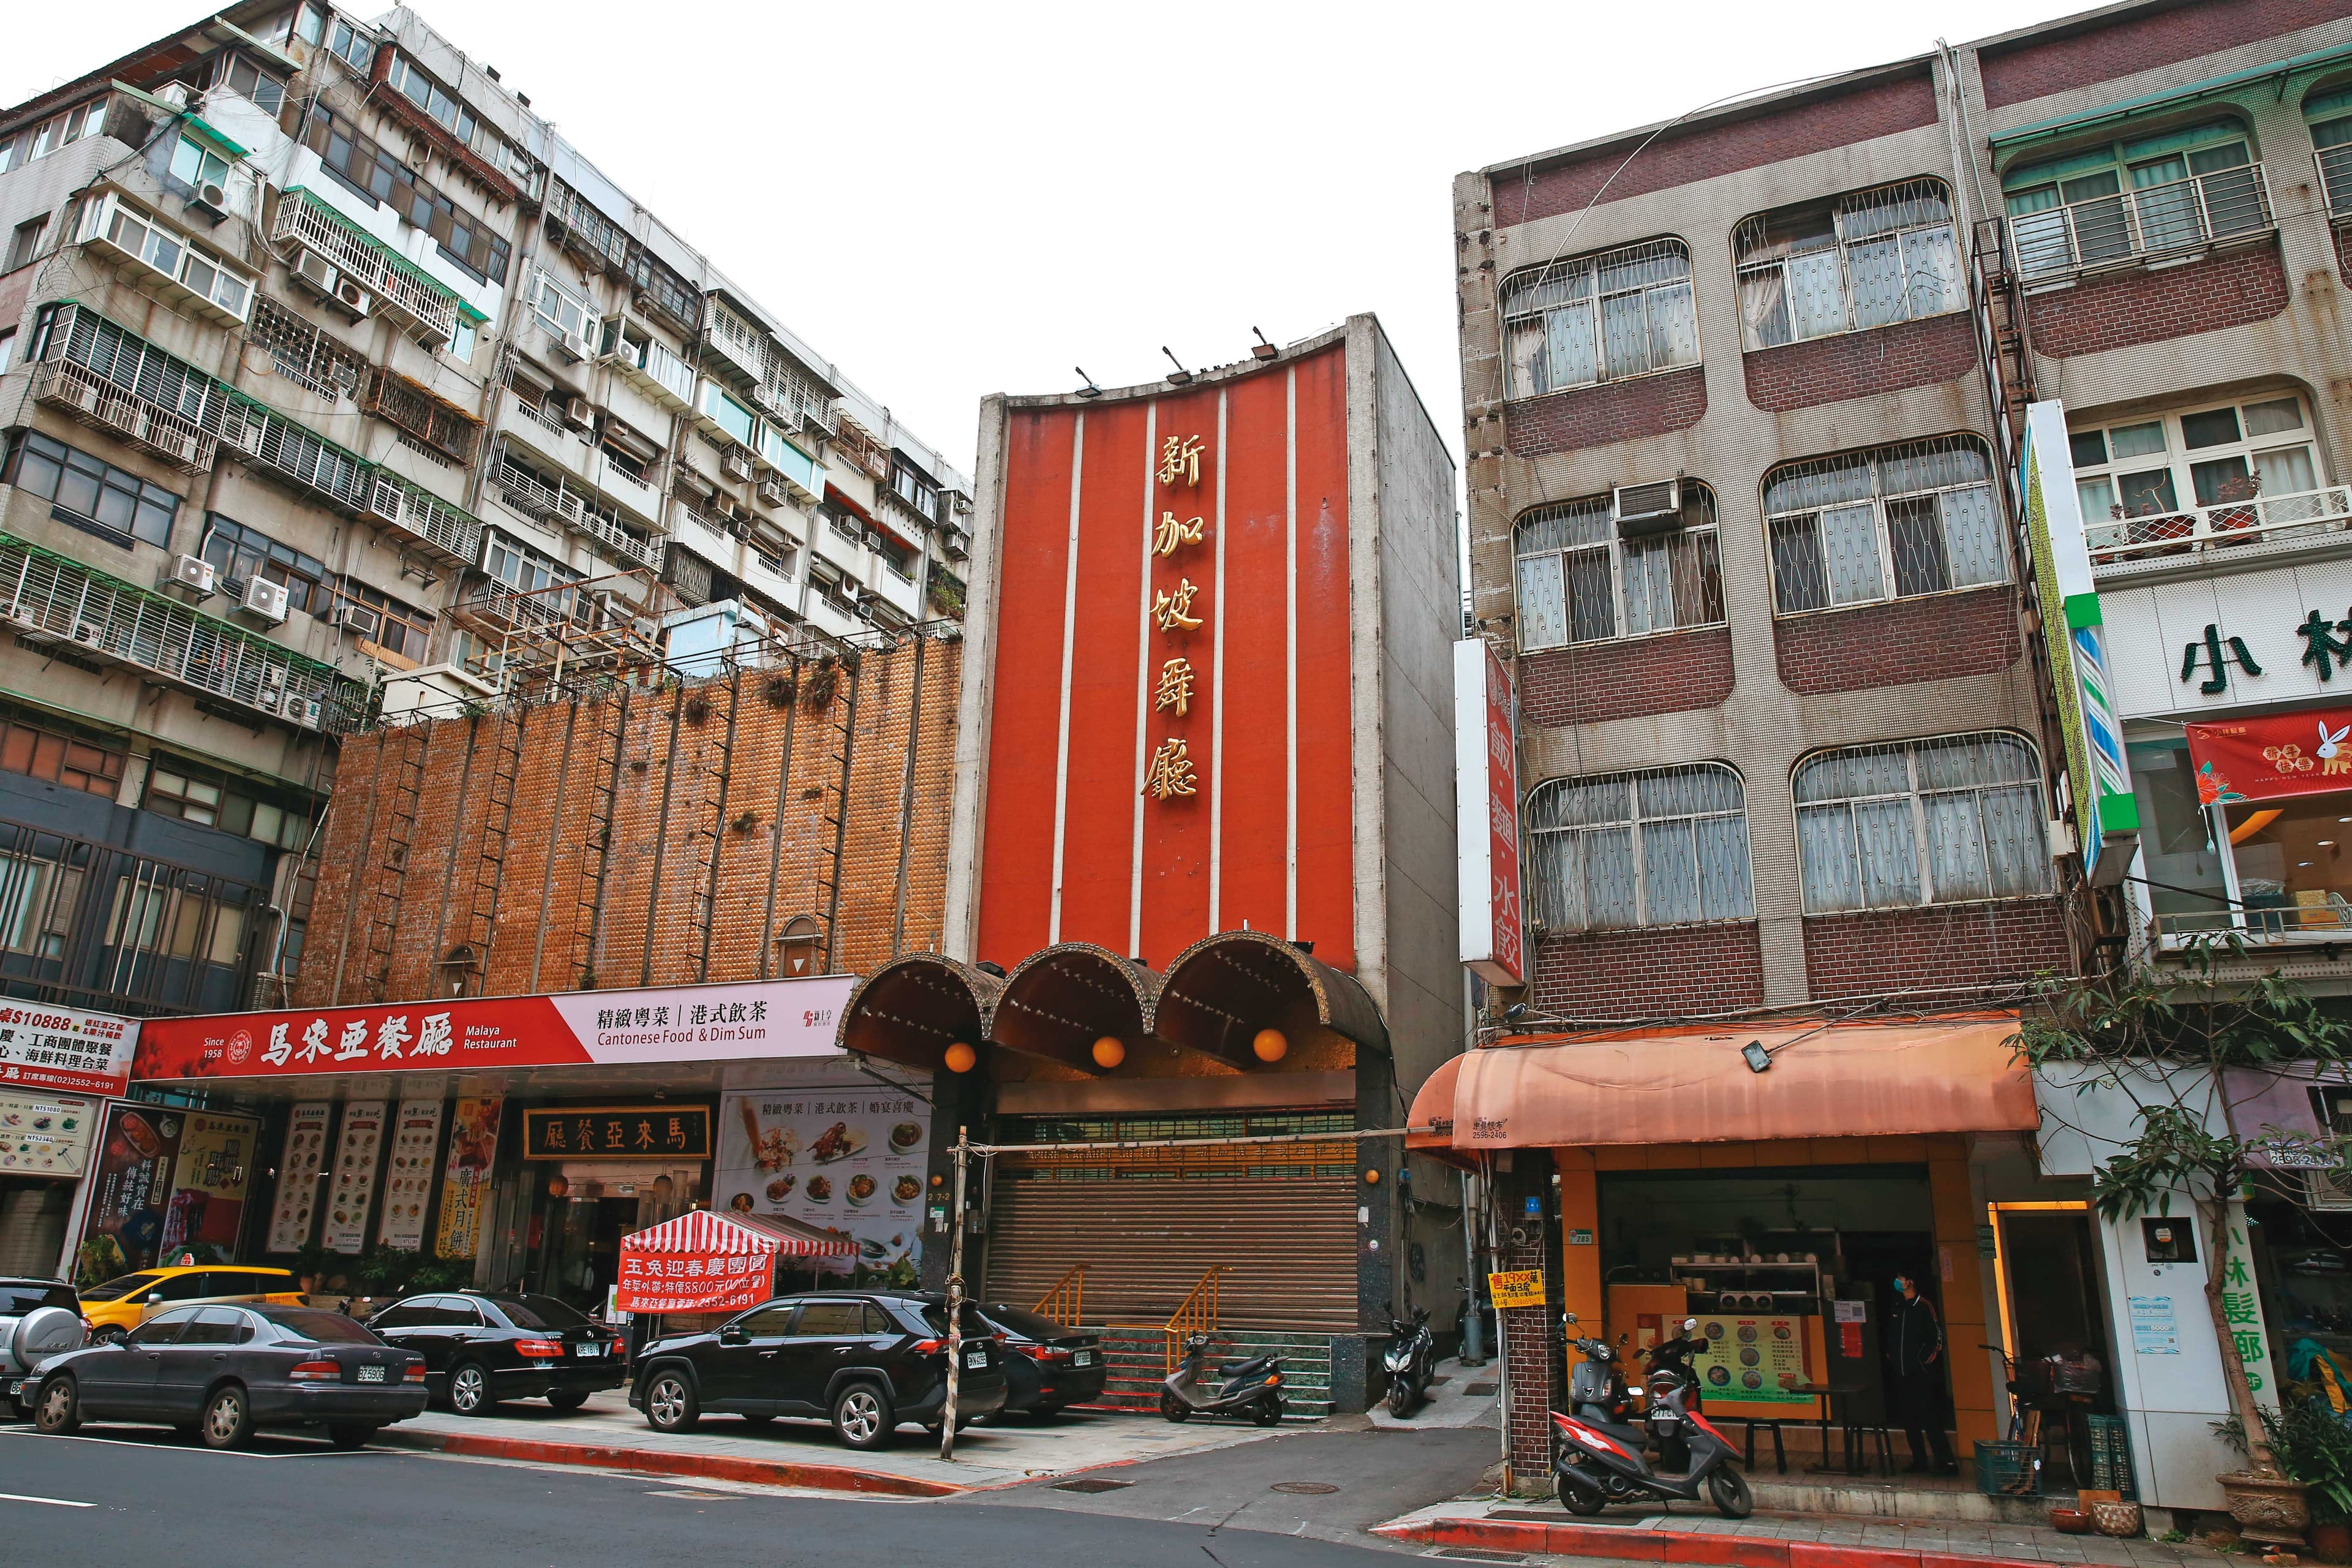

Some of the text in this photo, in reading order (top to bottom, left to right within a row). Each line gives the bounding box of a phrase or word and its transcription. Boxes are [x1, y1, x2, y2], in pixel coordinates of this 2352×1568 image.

[1141, 434, 1206, 801] 新加坡舞廳
[2265, 746, 2297, 759] 新年
[2278, 759, 2310, 771] 快樂
[597, 1001, 767, 1029] 精緻粵菜 港式飲茶
[466, 1025, 500, 1038] Malaya
[598, 1027, 766, 1046] Cantonese Food & Dim Sum
[204, 1038, 224, 1046] Since
[261, 1012, 452, 1066] 馬來亞餐廳
[464, 1038, 517, 1049] Restaurant
[204, 1049, 222, 1058] 1958
[762, 1101, 914, 1115] 精緻粵菜 港式飲茶 婚宴喜慶
